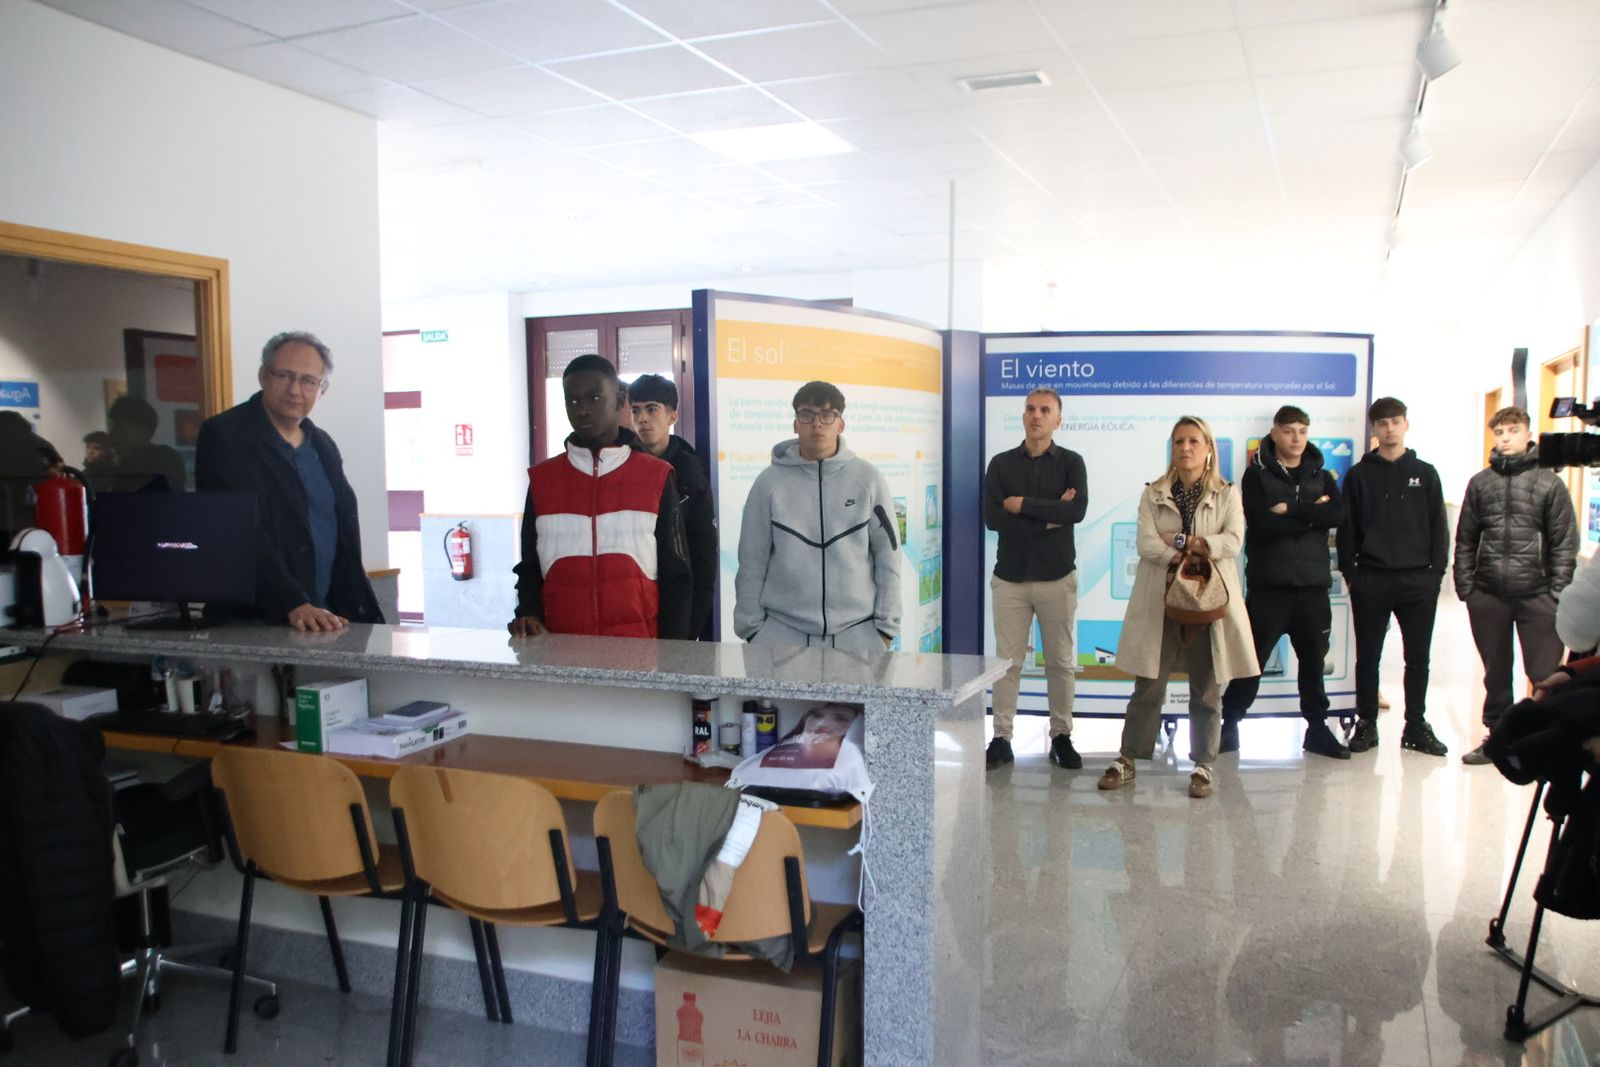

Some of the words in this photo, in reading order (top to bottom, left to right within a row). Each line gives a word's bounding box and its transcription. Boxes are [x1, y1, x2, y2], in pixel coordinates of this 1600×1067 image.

[727, 338, 747, 363] El
[754, 340, 784, 365] sol
[1001, 359, 1019, 378] El
[1026, 359, 1095, 378] viento
[1001, 382, 1024, 390] Masas
[1065, 381, 1111, 389] movimiento
[1112, 380, 1141, 389] debido
[1149, 380, 1160, 388] las
[1161, 380, 1203, 389] diferencias
[1205, 381, 1215, 389] de
[1217, 382, 1262, 391] temperatura
[1302, 383, 1315, 391] por
[694, 727, 710, 736] RAL
[737, 1028, 751, 1042] LA
[754, 1031, 798, 1049] CHARRA
